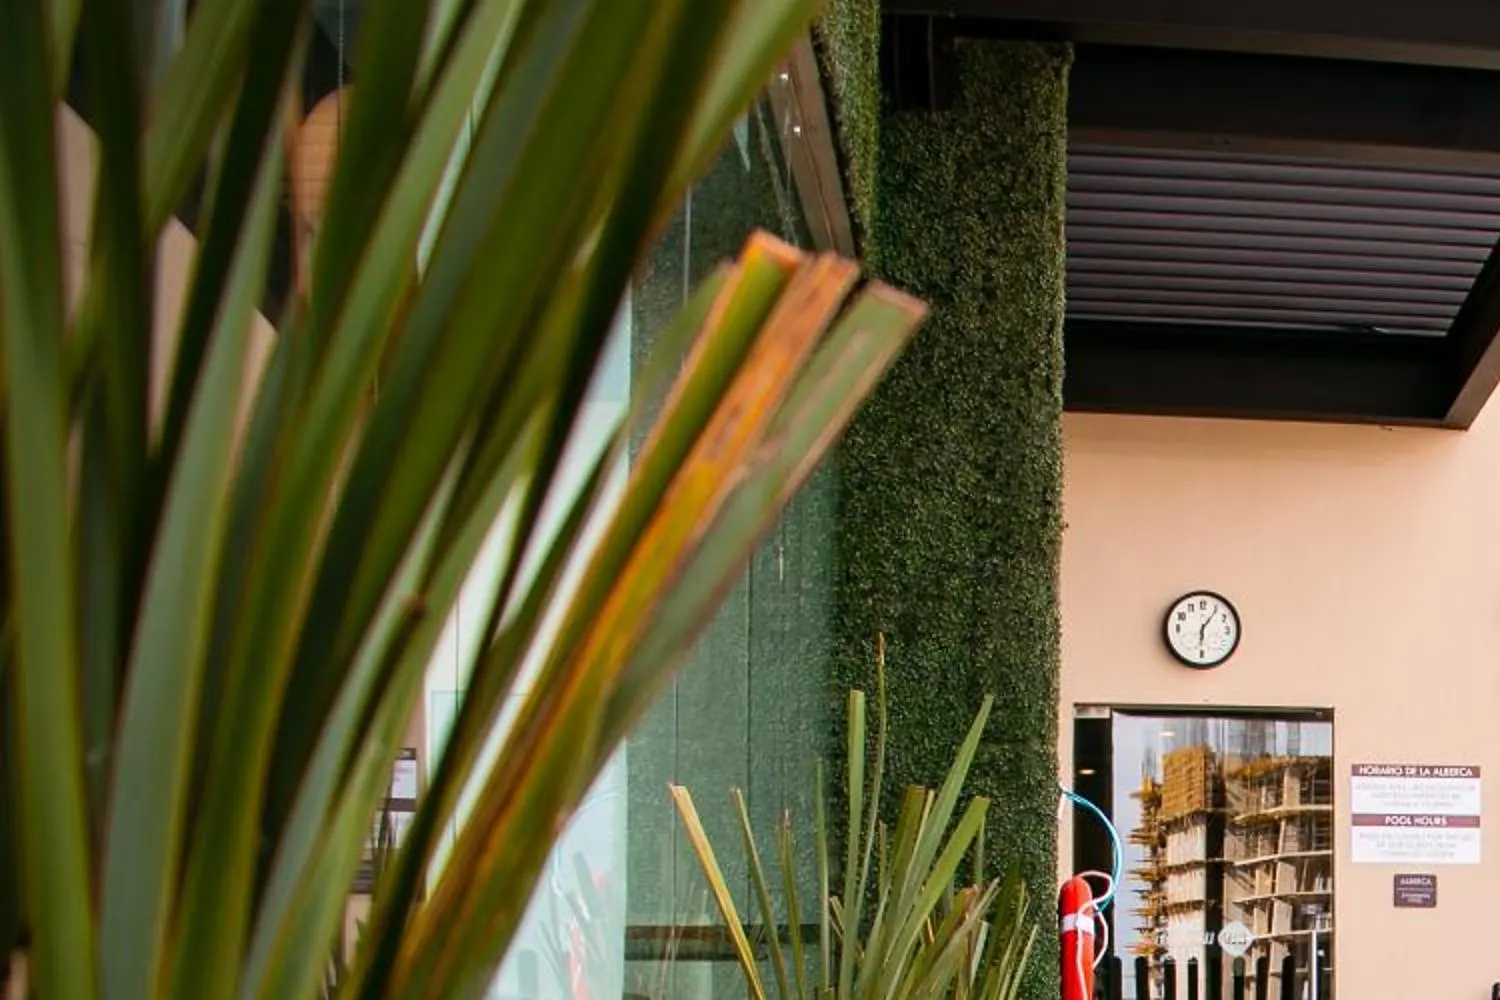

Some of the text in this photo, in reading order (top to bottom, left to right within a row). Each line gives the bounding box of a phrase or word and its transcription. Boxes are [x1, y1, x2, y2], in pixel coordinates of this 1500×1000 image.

[1359, 766, 1473, 777] HORARIO DE LA ALBERCA
[1385, 816, 1447, 826] POOL HOURS
[1400, 877, 1431, 886] ALBERCA
